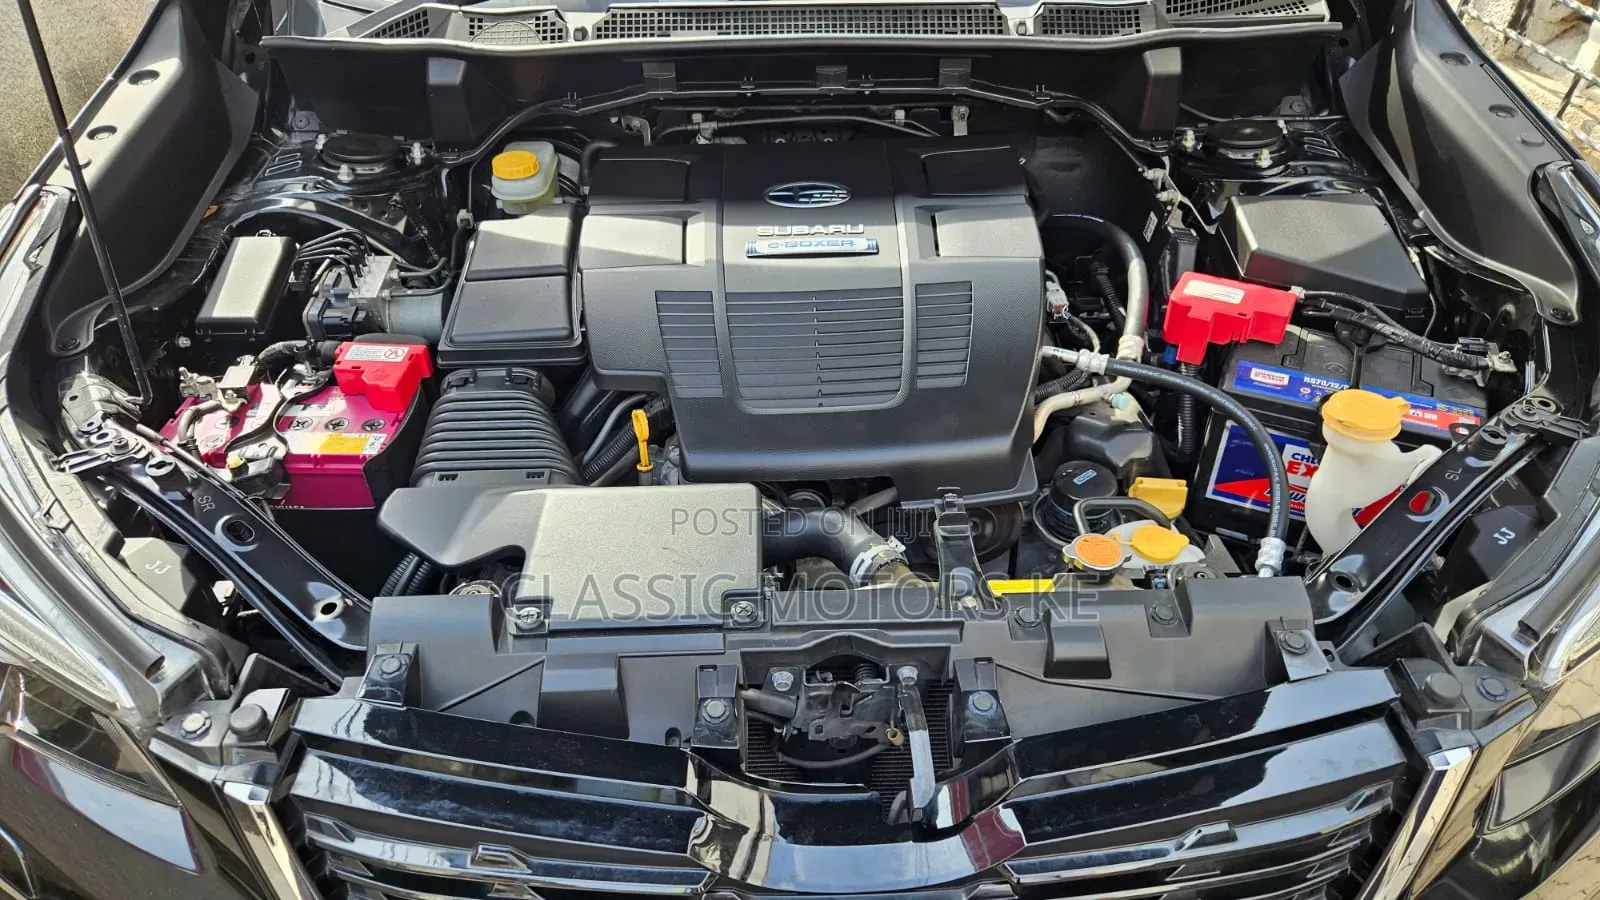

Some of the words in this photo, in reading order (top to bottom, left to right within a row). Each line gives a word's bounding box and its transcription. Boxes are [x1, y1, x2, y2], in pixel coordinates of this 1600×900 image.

[757, 223, 865, 236] SUBARU
[1444, 466, 1462, 481] SL
[198, 495, 216, 512] SR
